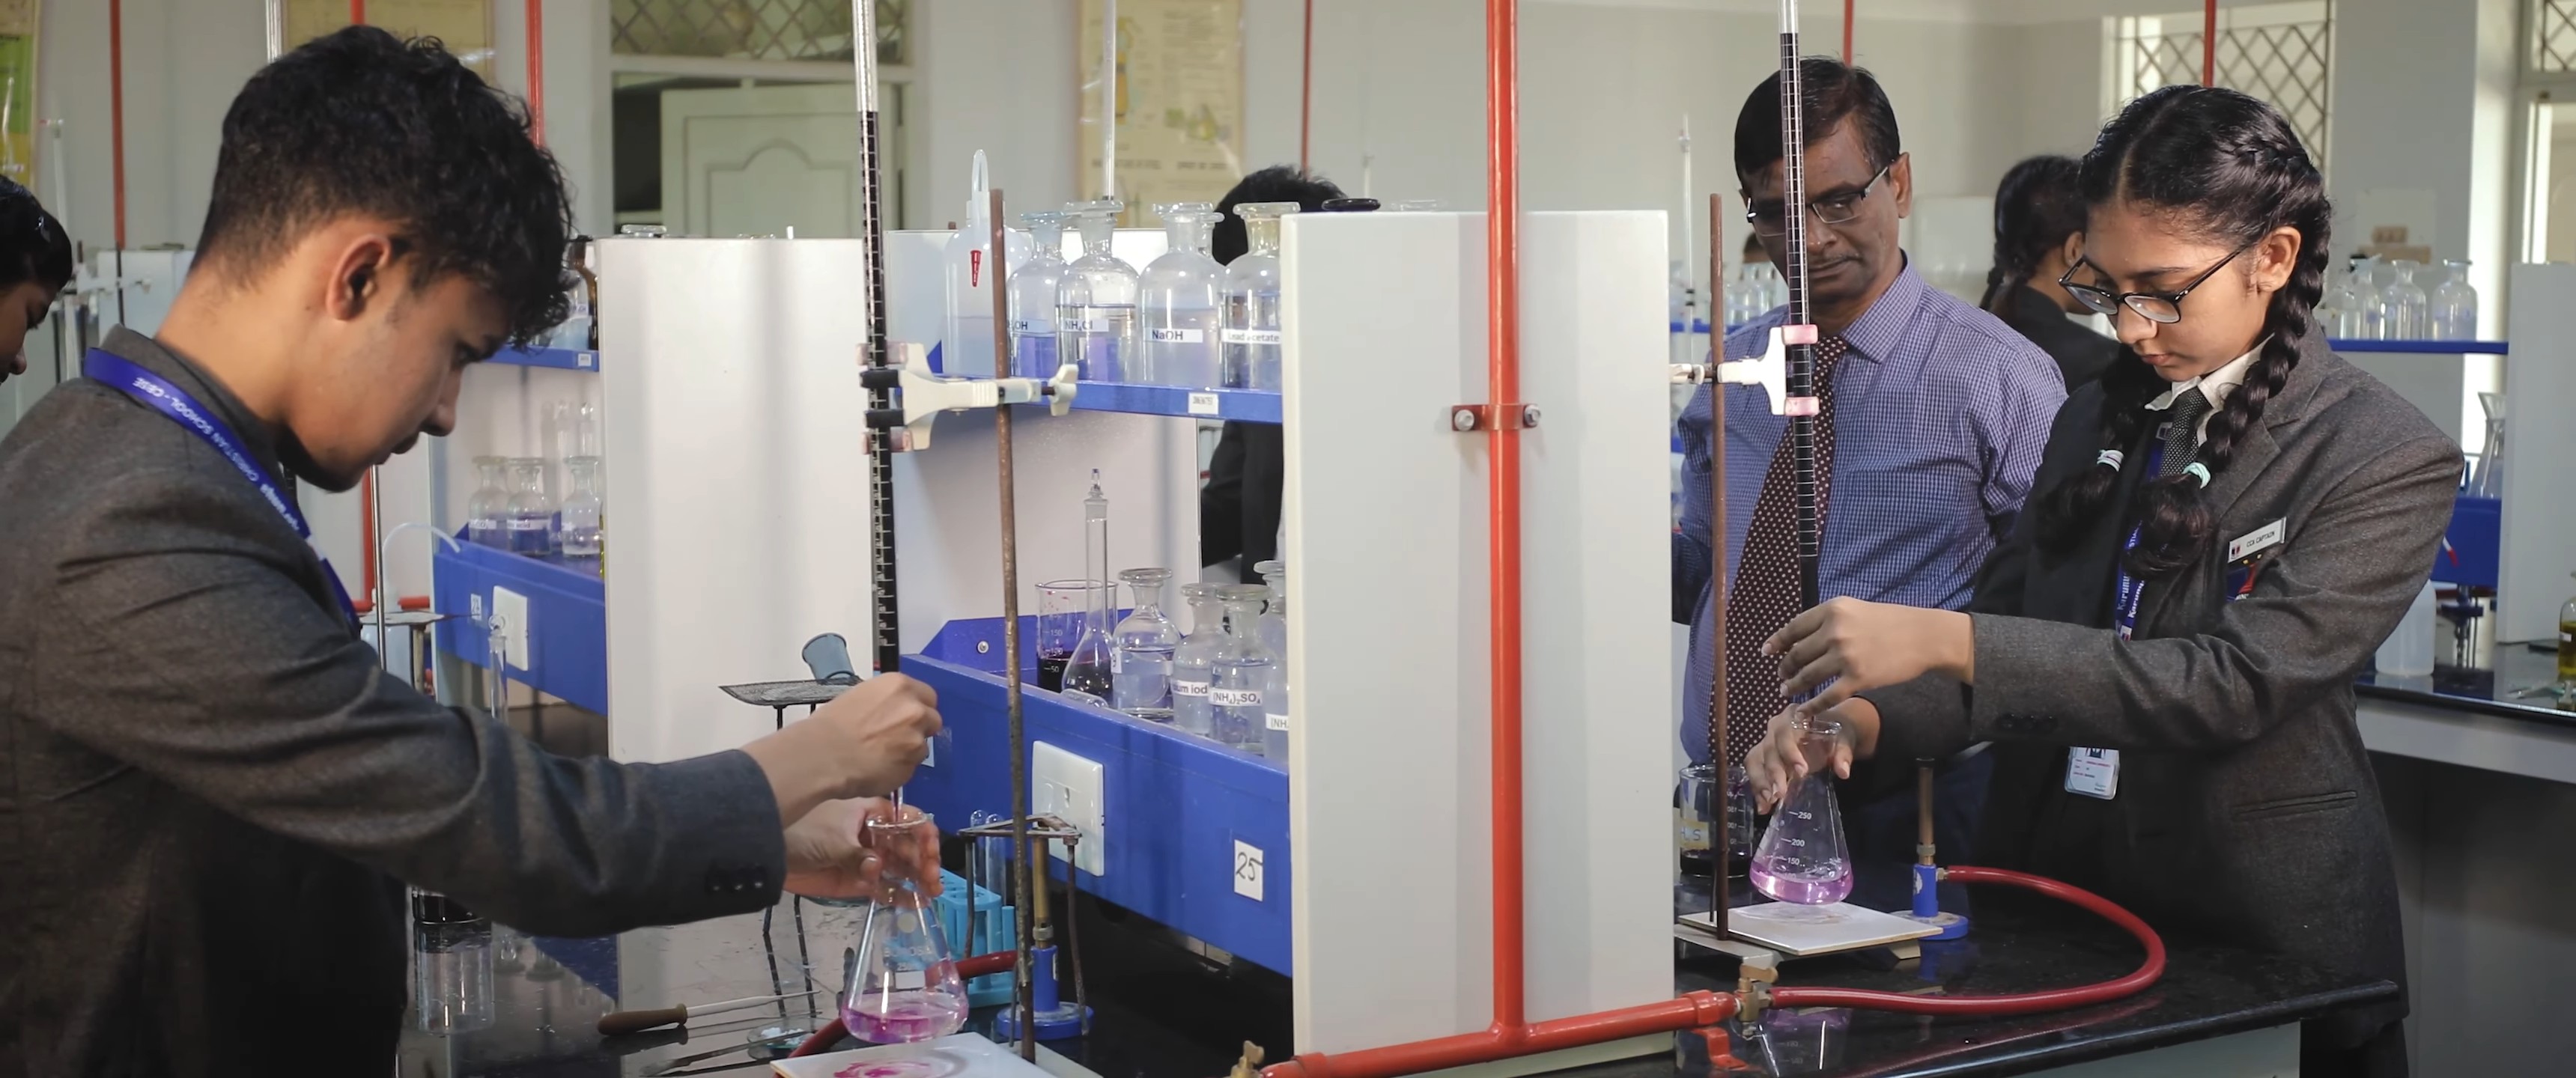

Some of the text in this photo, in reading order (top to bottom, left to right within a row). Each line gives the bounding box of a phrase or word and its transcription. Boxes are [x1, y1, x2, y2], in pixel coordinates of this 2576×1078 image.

[1151, 329, 1184, 341] NaOH
[1228, 332, 1245, 341] Lead
[170, 397, 214, 435] SCHOOL
[211, 432, 259, 481] CHRISTIAN
[2127, 579, 2145, 618] Karuny
[1191, 684, 1208, 694] iod
[1270, 717, 1289, 729] (NH
[1798, 811, 1812, 820] 250
[1791, 838, 1805, 847] 200
[1236, 851, 1263, 882] 25
[1787, 857, 1800, 865] 150
